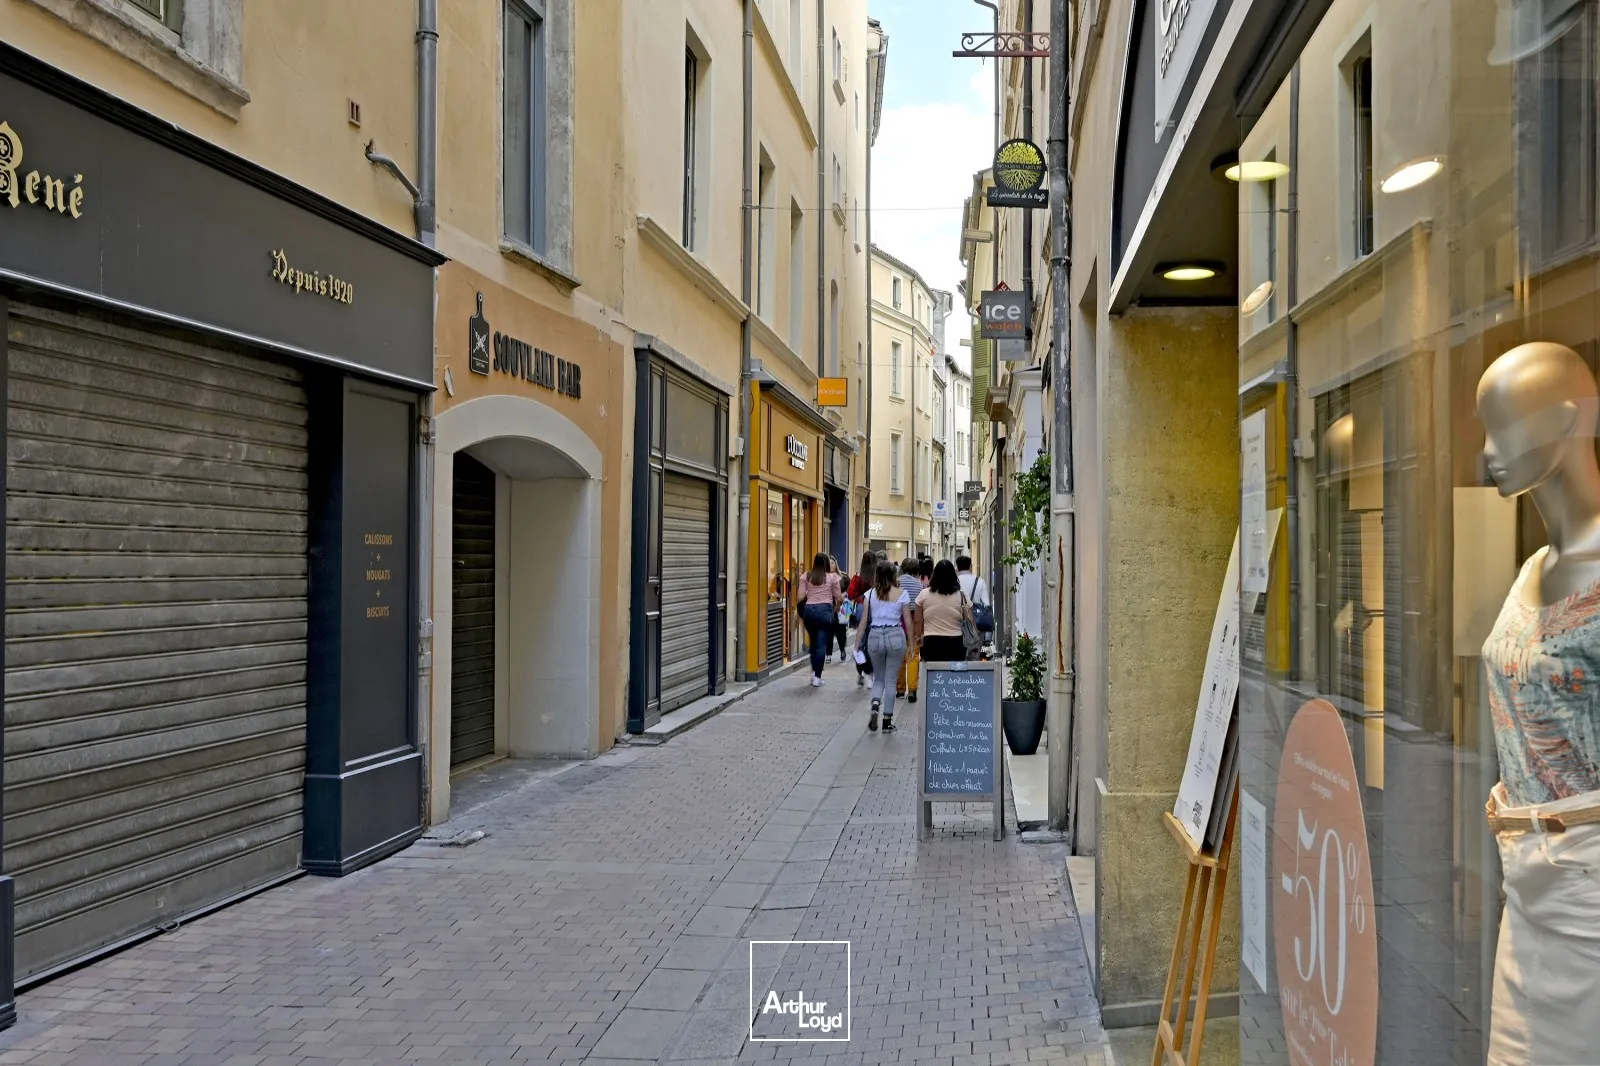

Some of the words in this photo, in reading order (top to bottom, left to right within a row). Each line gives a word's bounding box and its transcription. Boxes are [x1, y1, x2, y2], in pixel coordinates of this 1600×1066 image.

[272, 247, 328, 296] Depuis
[328, 274, 354, 305] 1920
[493, 330, 556, 391] SOUVLAKI
[557, 357, 582, 400] BAR
[364, 533, 393, 545] CALISSONS
[366, 569, 391, 581] NOUGATS
[366, 605, 390, 618] BISCUITS
